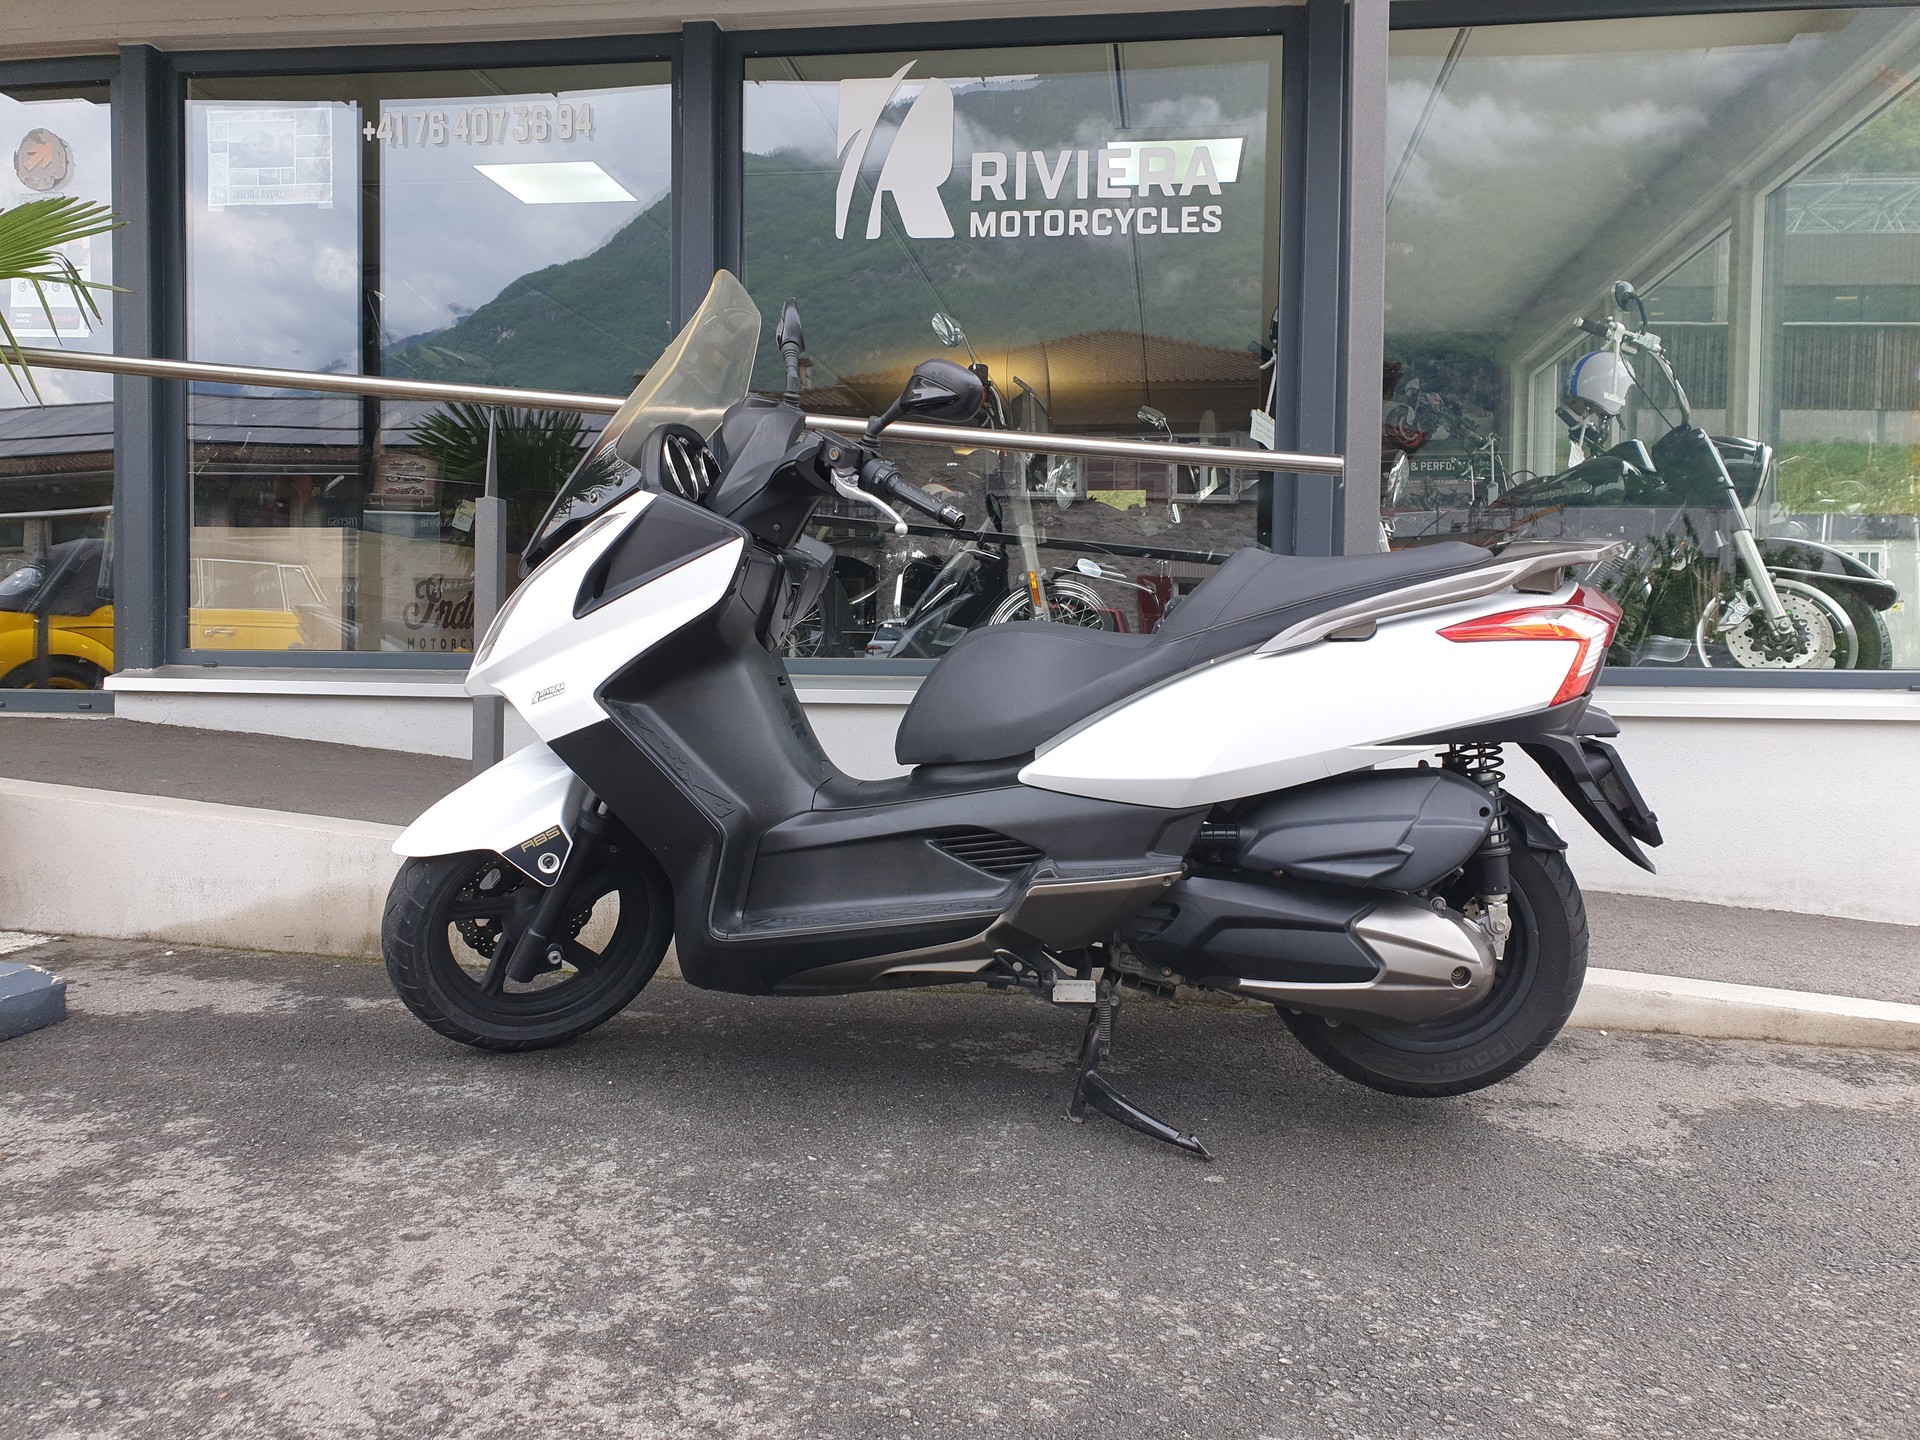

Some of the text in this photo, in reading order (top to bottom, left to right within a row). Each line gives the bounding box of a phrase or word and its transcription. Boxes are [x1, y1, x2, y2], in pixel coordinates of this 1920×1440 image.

[363, 103, 593, 146] +41 76 407 36 94
[970, 146, 1223, 202] RIVIERA
[970, 205, 1223, 238] MOTORCYCLES
[521, 826, 561, 853] ABS
